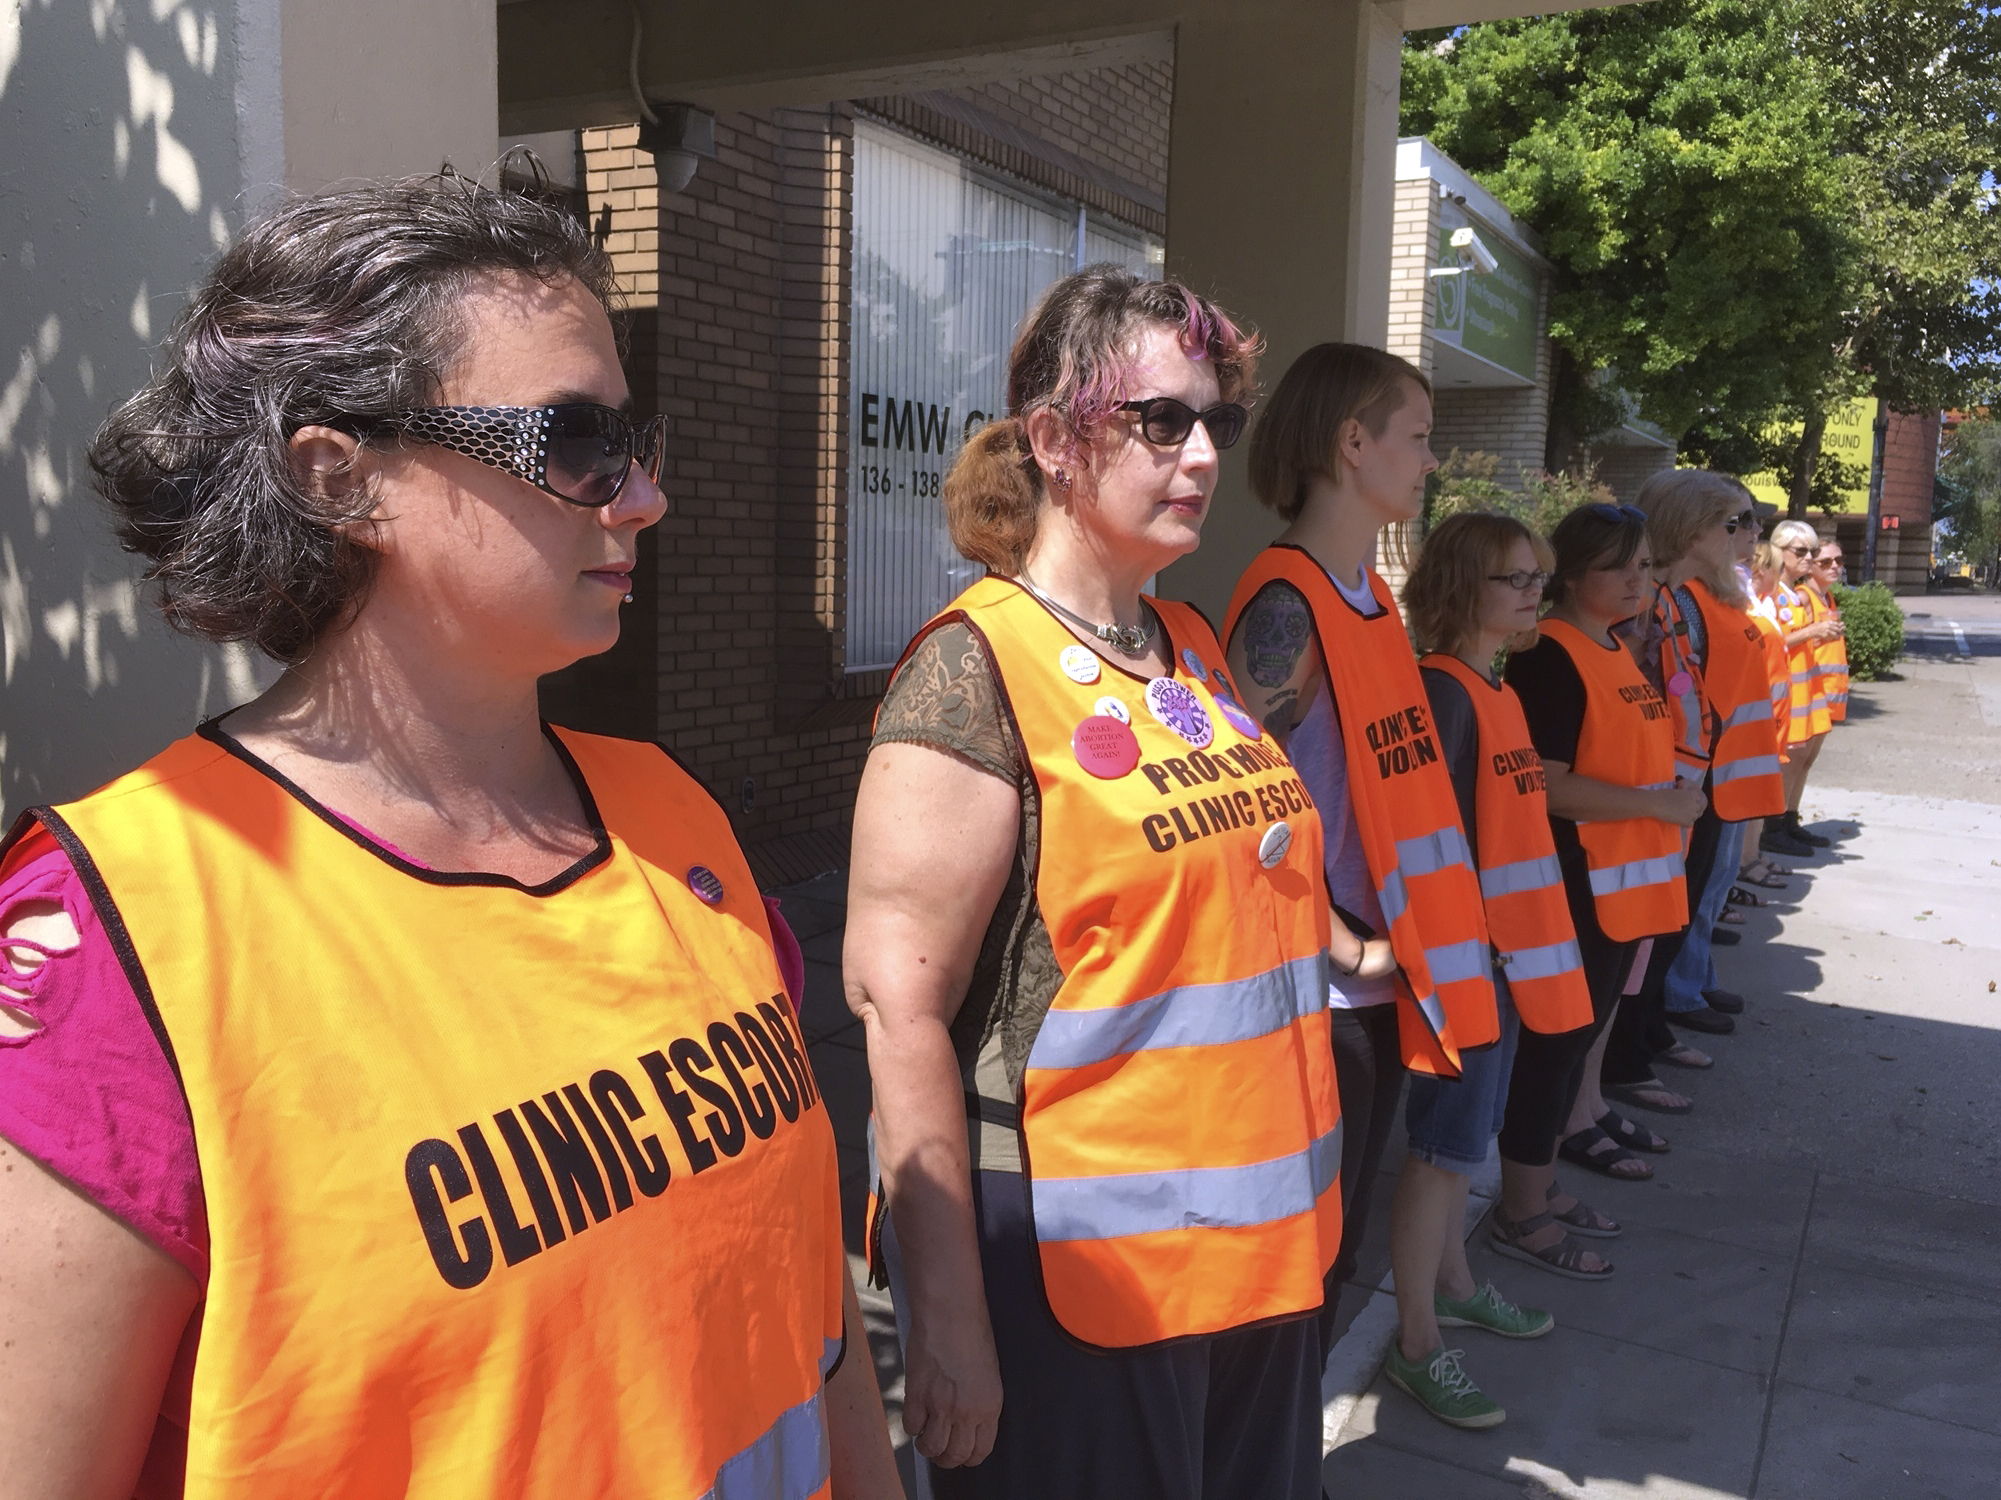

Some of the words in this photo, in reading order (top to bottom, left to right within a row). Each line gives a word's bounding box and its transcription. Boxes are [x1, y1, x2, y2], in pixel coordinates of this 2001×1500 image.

[861, 393, 950, 455] EMW
[1832, 412, 1862, 428] ONLY
[861, 466, 891, 495] 136
[912, 470, 940, 498] 138
[1152, 679, 1167, 700] PUSSY
[1168, 679, 1197, 701] POWER
[1079, 732, 1124, 743] ABORTION
[1087, 725, 1112, 734] MAKE
[1089, 742, 1118, 751] GREAT
[1091, 750, 1121, 760] AGAIN!
[1142, 790, 1256, 853] CLINIC
[1255, 778, 1317, 823] ESCO
[405, 1069, 671, 1290] CLINIC
